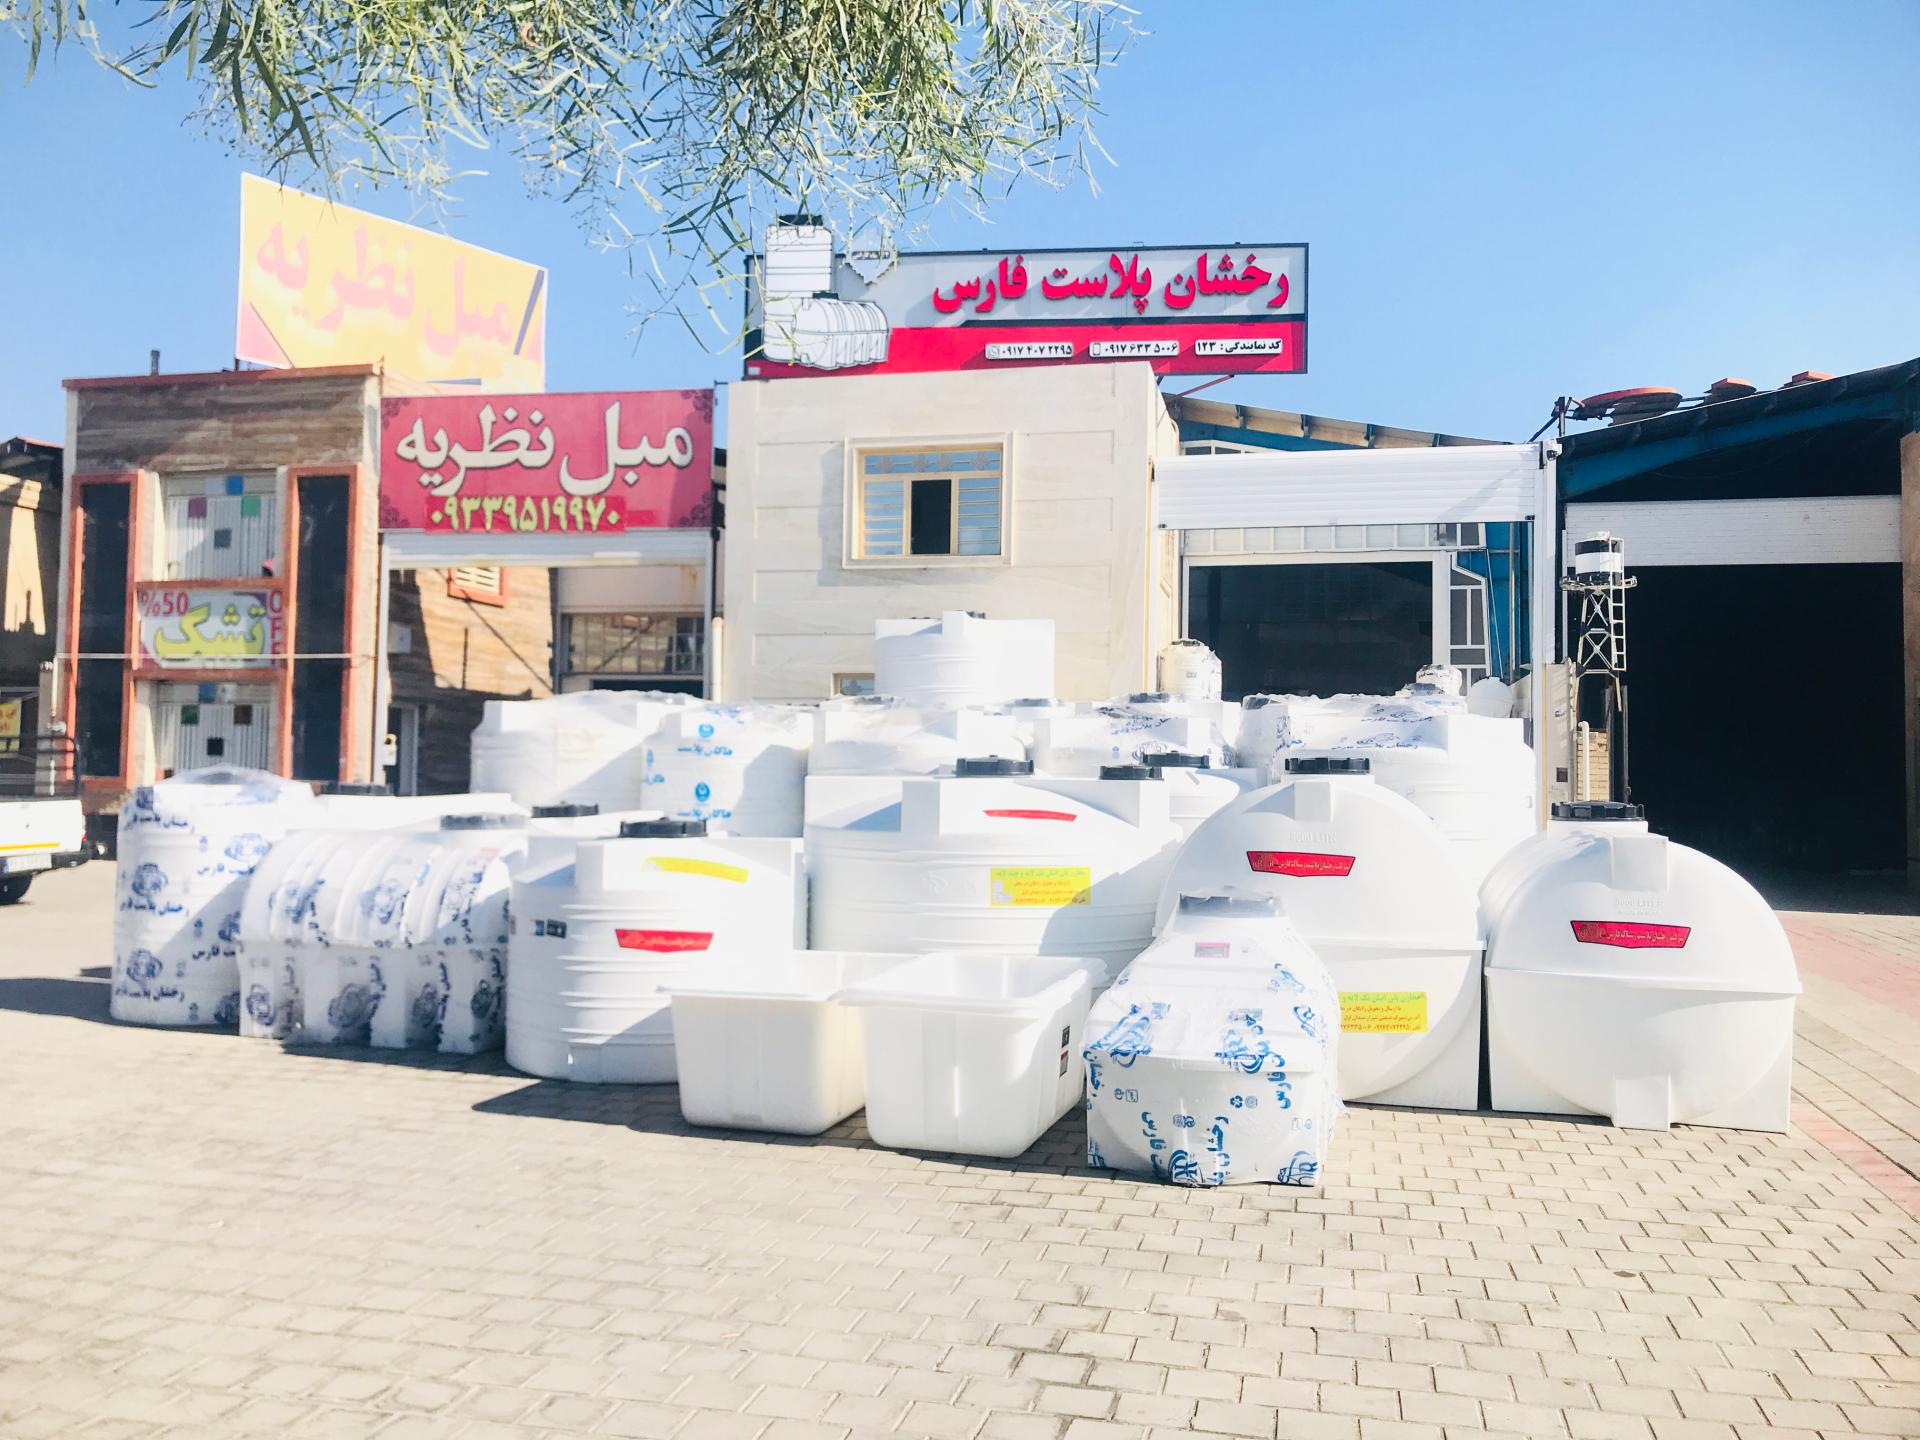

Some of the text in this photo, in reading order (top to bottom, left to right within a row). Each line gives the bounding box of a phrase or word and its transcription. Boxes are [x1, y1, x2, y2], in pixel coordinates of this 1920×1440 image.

[256, 223, 514, 358] مبل نظریه
[932, 252, 1289, 313] رخشان پلاست فارس
[1268, 339, 1282, 350] کد
[396, 400, 694, 497] مبل نظریه
[431, 495, 621, 532] ۰۹۳۳۹۵۱۹۹۷۰
[154, 602, 266, 661] تشک
[269, 589, 283, 665] OFF
